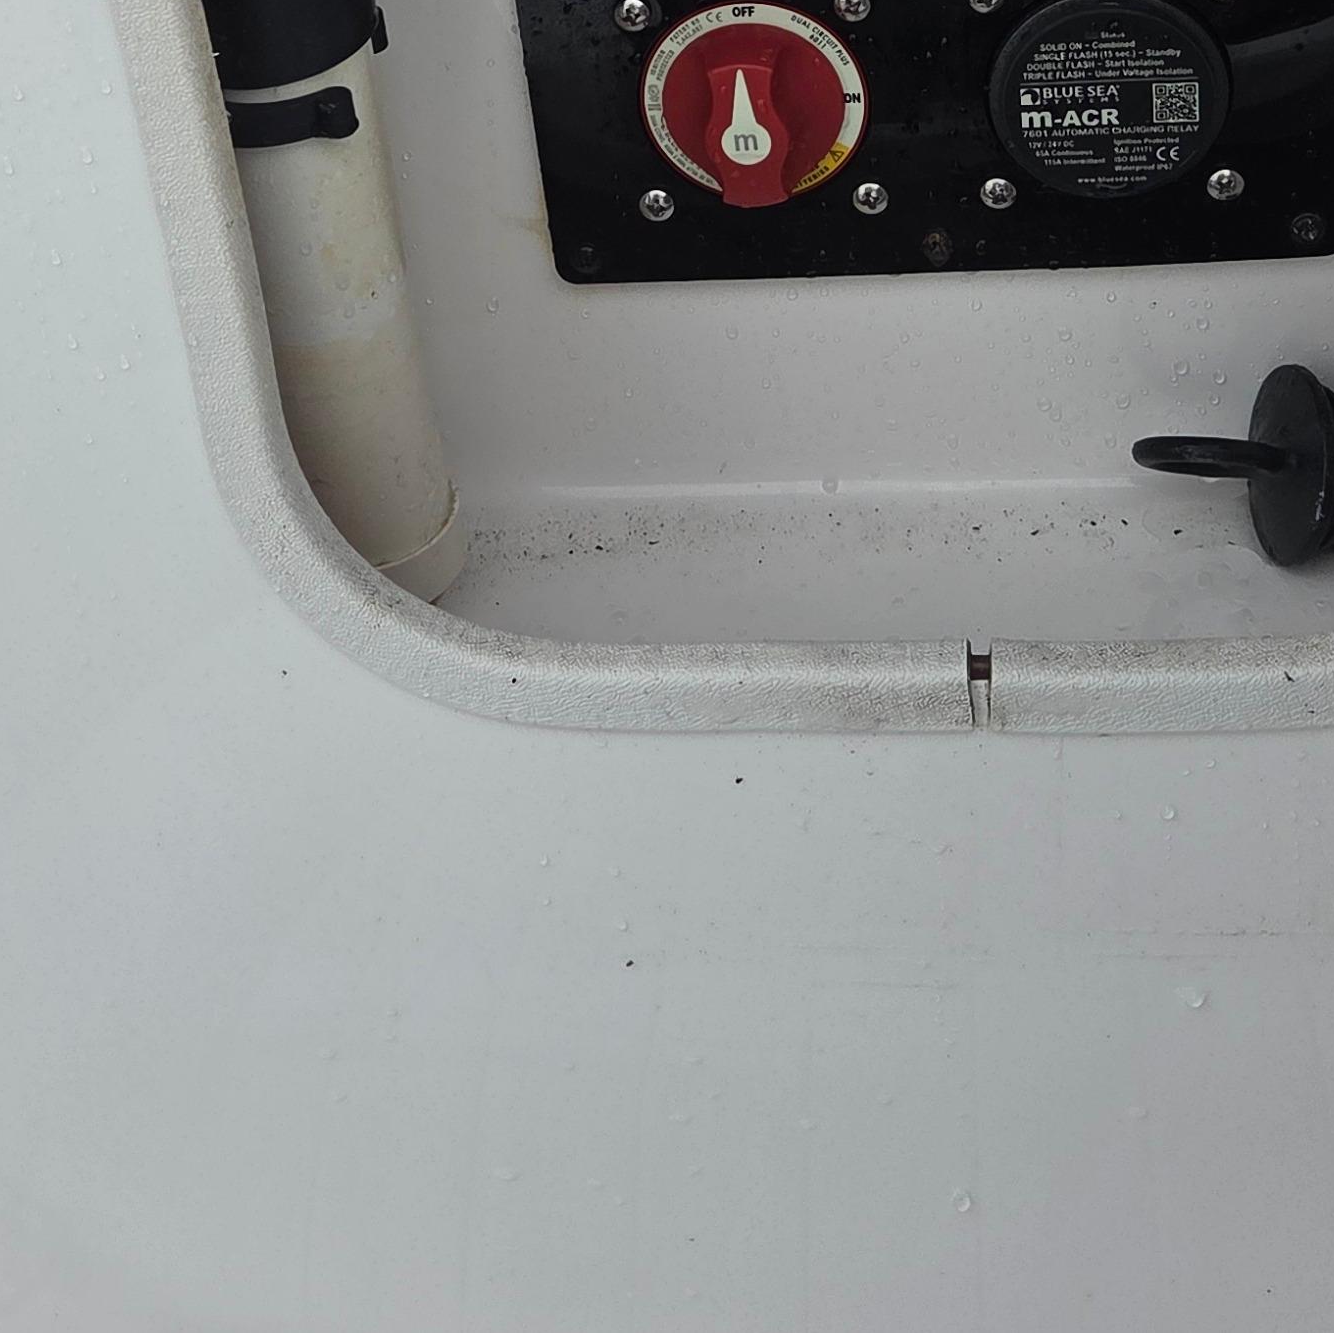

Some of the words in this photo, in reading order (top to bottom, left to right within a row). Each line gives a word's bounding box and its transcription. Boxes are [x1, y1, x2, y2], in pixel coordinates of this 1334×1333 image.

[732, 6, 755, 17] OFF
[790, 15, 811, 29] DUAL
[812, 26, 838, 49] CIRCUIT
[835, 49, 850, 66] PLUS
[1039, 43, 1067, 52] SOLID
[1069, 42, 1083, 51] ON
[1091, 40, 1136, 49] Combined
[1033, 53, 1065, 62] SINGLE
[1068, 51, 1098, 60] FLASH
[1145, 49, 1181, 58] Standby
[1026, 62, 1062, 71] DOUBLE
[1065, 60, 1095, 69] FLASH
[1104, 59, 1126, 68] Start
[1127, 58, 1165, 67] Isolation
[1022, 72, 1054, 81] TRIPLE
[1055, 70, 1085, 80] FLASH
[1094, 69, 1120, 78] Under
[1122, 68, 1154, 78] Voltage
[1156, 67, 1194, 76] Isolation
[844, 93, 861, 103] ON
[1042, 86, 1084, 99] BLUE
[1021, 108, 1120, 128] m-ACR
[1022, 130, 1049, 139] 7601
[1051, 127, 1110, 137] AUTOMATIC
[1111, 125, 1165, 135] CHARGING
[1167, 124, 1200, 133] RELAY
[734, 134, 758, 151] m
[1063, 140, 1075, 148] DC
